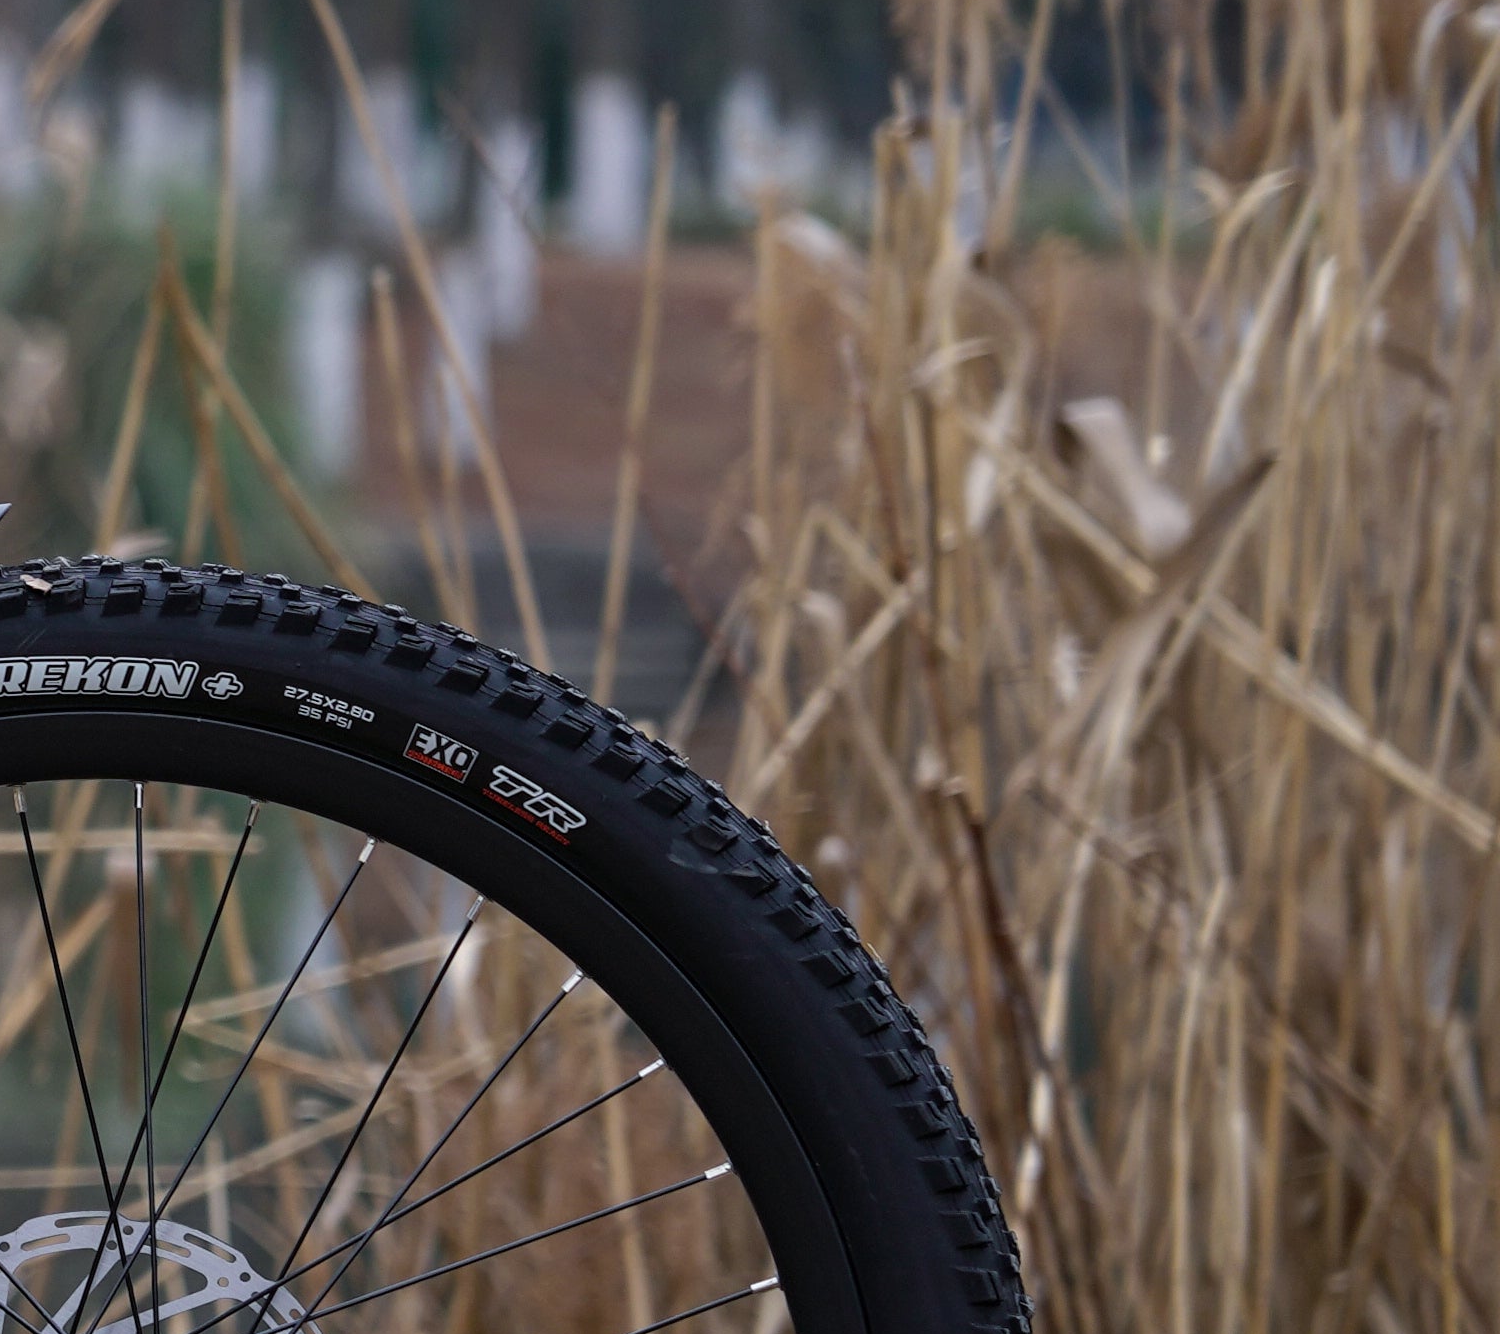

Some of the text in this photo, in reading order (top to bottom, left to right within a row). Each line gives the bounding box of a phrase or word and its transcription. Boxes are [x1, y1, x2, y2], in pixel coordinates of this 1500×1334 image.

[283, 685, 375, 723] 27.5X2.80
[298, 704, 353, 730] 35 PSI
[409, 727, 477, 775] EXO
[489, 765, 587, 834] TR
